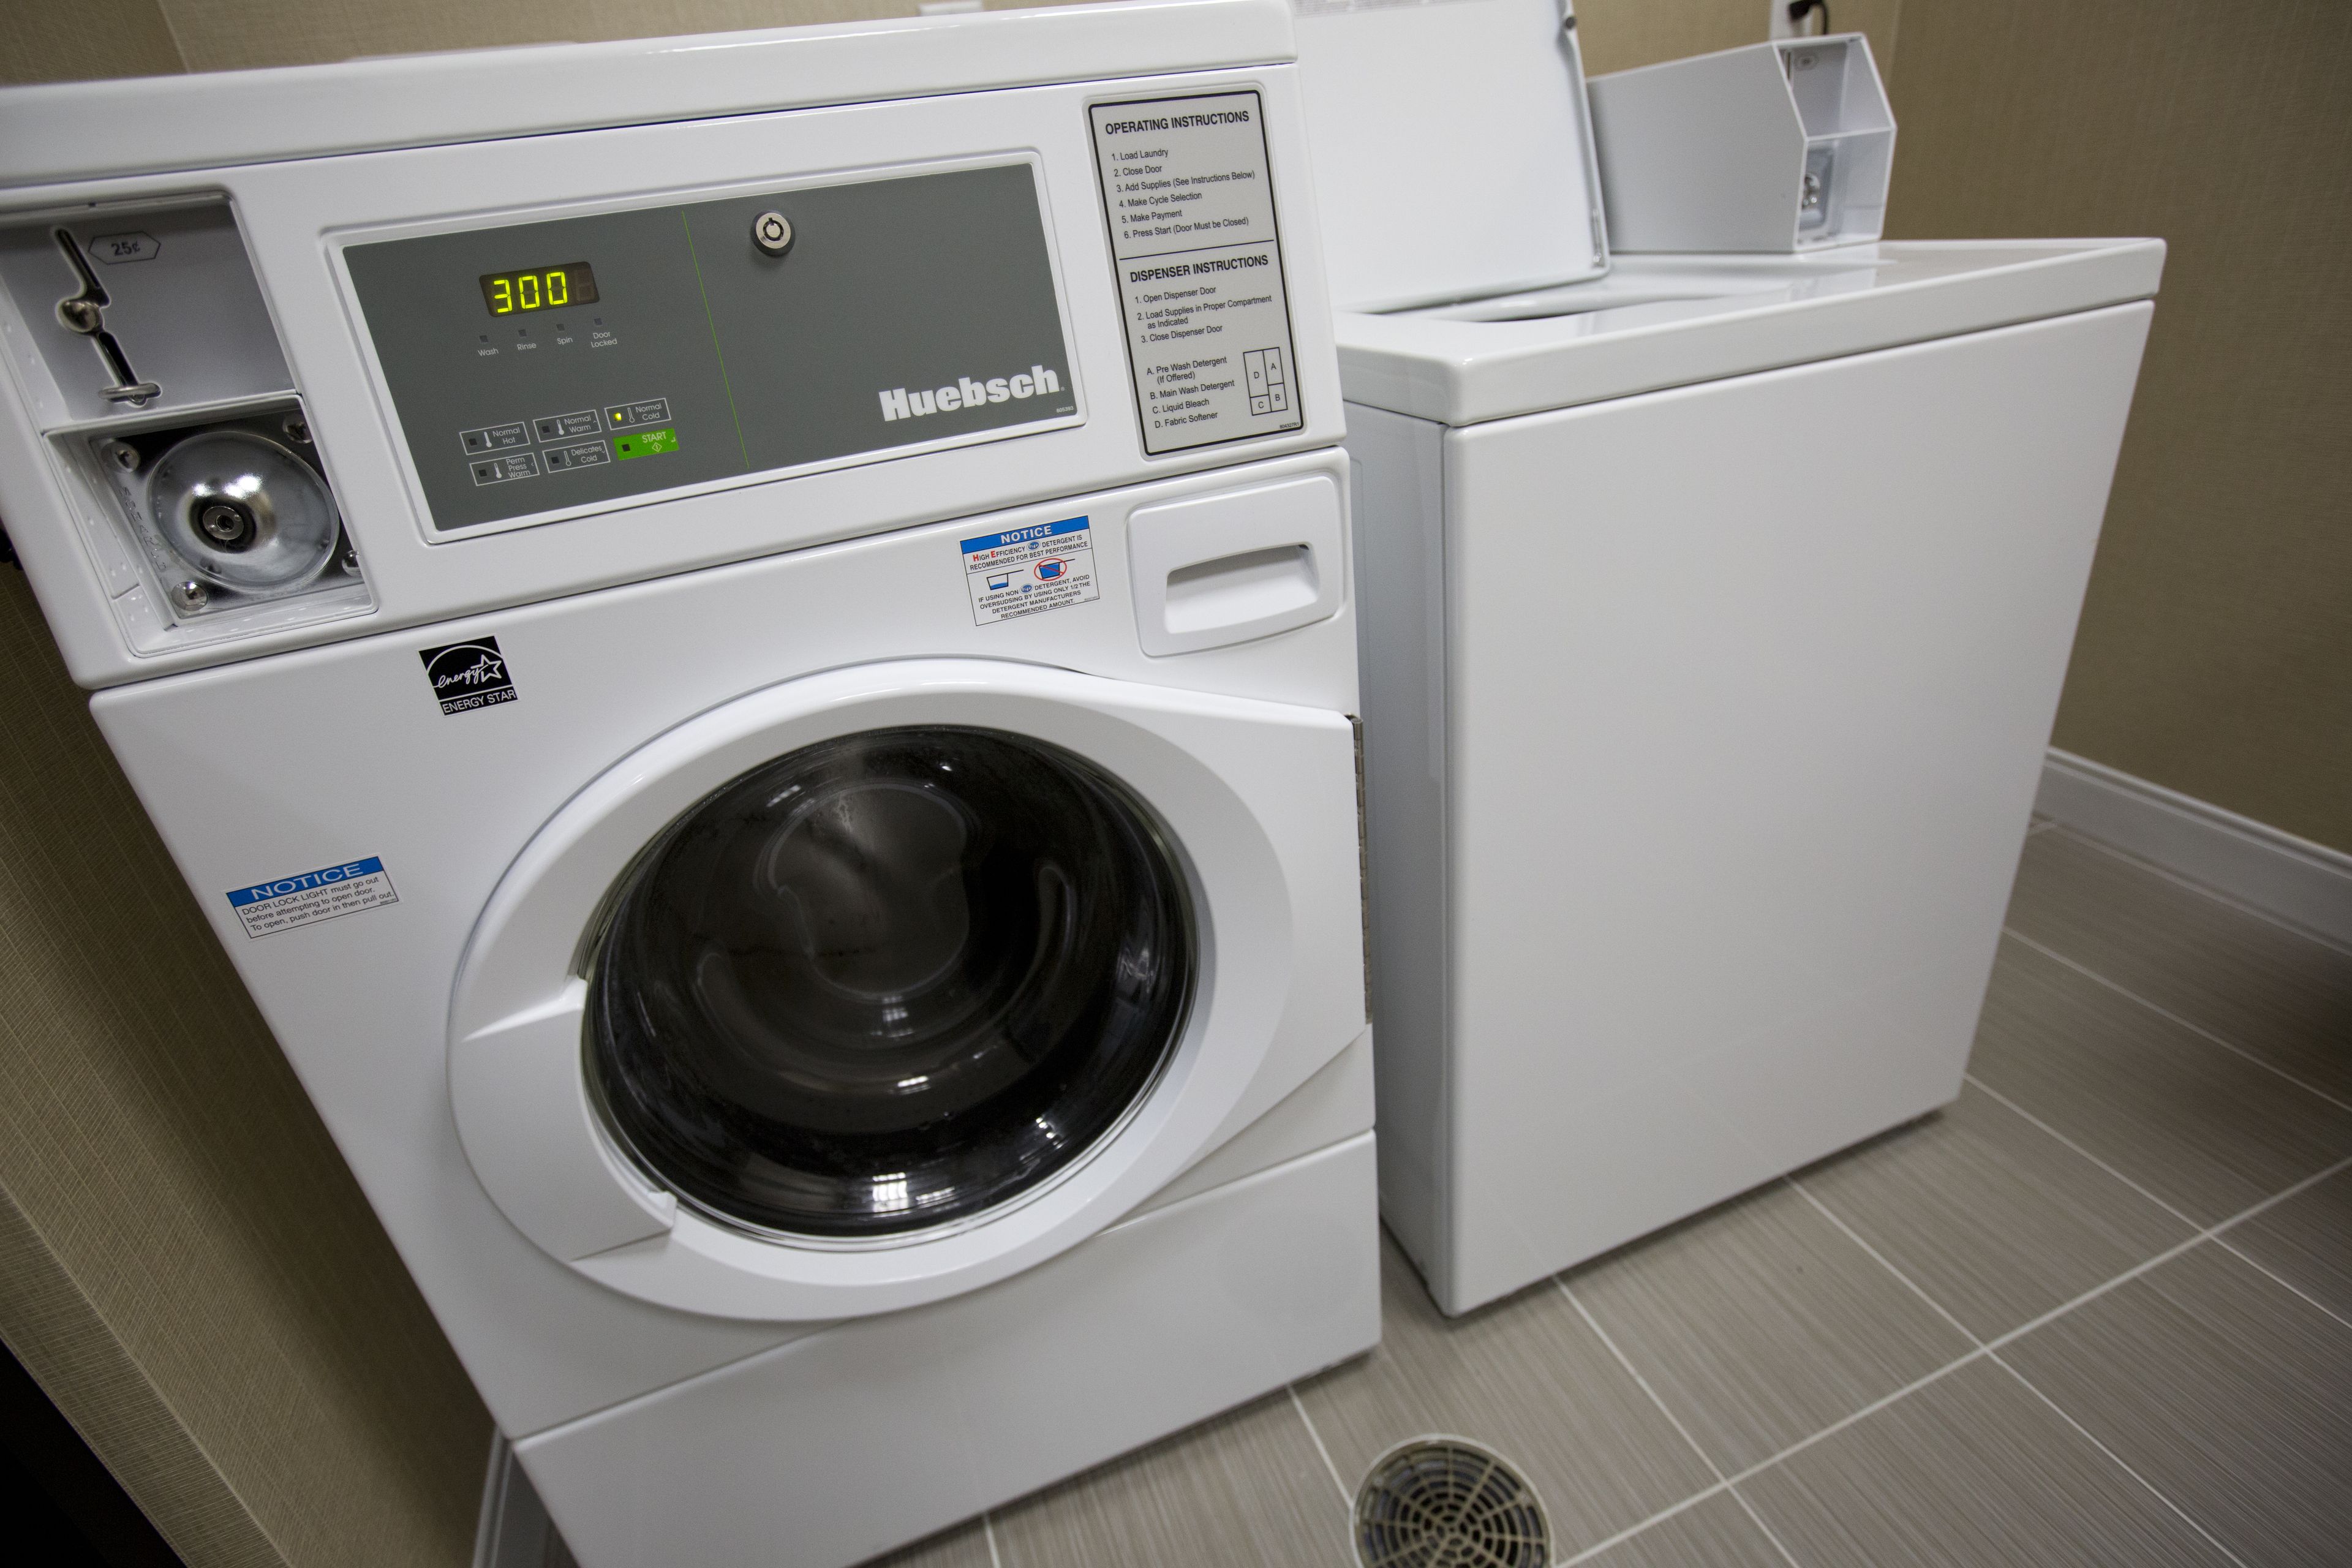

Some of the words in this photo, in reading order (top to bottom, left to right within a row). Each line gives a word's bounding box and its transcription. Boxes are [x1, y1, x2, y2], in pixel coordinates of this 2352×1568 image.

[1106, 119, 1169, 134] OPERATING
[1172, 111, 1249, 128] INSTRUCTIONS
[1120, 151, 1138, 160] Load
[1140, 149, 1168, 158] Laundry
[1123, 167, 1143, 176] Close
[1125, 183, 1139, 192] Add
[1141, 180, 1171, 191] Supplies
[1173, 178, 1189, 187] (See
[1191, 175, 1230, 185] Instructions
[1232, 171, 1254, 180] Below)
[1128, 198, 1147, 208] Make
[1150, 195, 1169, 206] Cycle
[1170, 192, 1202, 202] Selection
[1131, 214, 1150, 222] Make
[1152, 209, 1182, 221] Payment
[1133, 228, 1153, 238] Press
[1155, 225, 1171, 235] Start
[1174, 224, 1192, 235] (Door
[1194, 222, 1210, 231] Must
[1223, 217, 1248, 227] Closed)
[111, 240, 140, 256] 25¢
[1130, 265, 1190, 282] DISPENSER
[1193, 255, 1268, 274] INSTRUCTIONS
[494, 272, 568, 312] 300
[1144, 295, 1163, 304] Open
[1164, 289, 1197, 301] Dispenser
[1200, 286, 1216, 295] Door
[1146, 310, 1163, 319] Load
[1165, 306, 1194, 318] Supplies
[1204, 301, 1226, 312] Proper
[1228, 295, 1272, 309] Compartment
[1158, 317, 1188, 328] Indicated
[591, 338, 617, 348] Locked
[1150, 333, 1169, 342] Close
[1171, 328, 1205, 341] Dispenser
[1170, 361, 1191, 371] Wash
[1193, 356, 1227, 369] Detergent
[1166, 372, 1195, 382] Offered)
[1160, 389, 1177, 398] Main
[1179, 385, 1199, 394] Wash
[1201, 380, 1234, 393] Detergent
[636, 404, 662, 413] Normal
[1163, 402, 1183, 413] Liquid
[1186, 399, 1209, 409] Bleach
[565, 415, 591, 424] Normal
[1165, 417, 1186, 426] Fabric
[1189, 412, 1218, 423] Softener
[492, 428, 520, 437] Normal
[570, 424, 590, 433] Warm
[642, 432, 666, 443] START
[571, 446, 602, 456] Delicates
[508, 470, 530, 478] Warm
[1001, 526, 1052, 544] NOTICE
[1042, 536, 1075, 548] DETERGENT
[970, 557, 1014, 570] RECOMMENDED
[1030, 550, 1044, 559] BEST
[1046, 541, 1088, 555] PERFORMANCE
[986, 592, 1004, 601] USING
[1035, 579, 1071, 590] DETERGENT,
[980, 597, 1023, 609] OVERSUDSING
[992, 602, 1028, 614] DETERGENT
[1030, 590, 1081, 606] MANUFACTURERS
[1001, 605, 1047, 619] RECOMMENDED
[1049, 599, 1074, 608] AMOUNT.
[442, 696, 484, 714] ENERGY
[487, 690, 516, 703] STAR
[251, 864, 363, 899] NOTICE
[242, 903, 272, 914] DOOR
[274, 896, 300, 907] LOCK
[301, 889, 328, 900] LIGHT
[331, 884, 352, 893] must
[353, 881, 363, 889] go
[246, 911, 274, 923] before
[276, 900, 320, 916] attempting
[332, 893, 352, 903] open
[354, 888, 375, 897] door.
[264, 919, 288, 929] open,
[290, 913, 310, 923] push
[312, 907, 331, 917] door
[342, 899, 361, 908] then
[363, 895, 377, 904] pull
